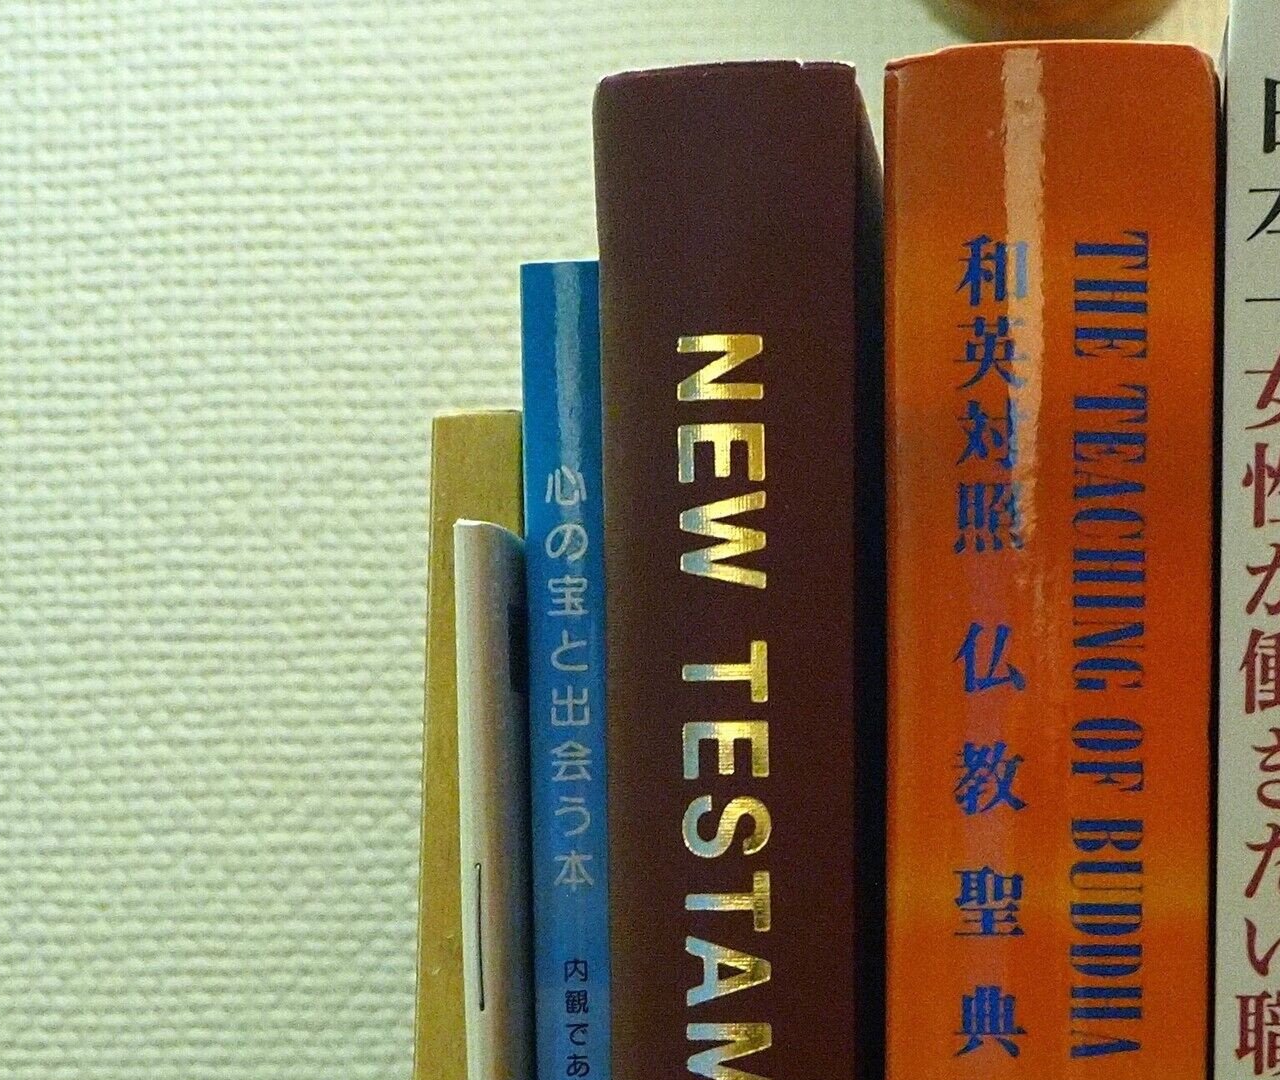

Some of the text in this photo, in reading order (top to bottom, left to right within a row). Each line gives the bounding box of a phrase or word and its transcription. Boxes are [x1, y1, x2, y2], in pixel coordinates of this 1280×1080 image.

[676, 332, 767, 590] NEW
[953, 233, 1030, 555] 和英対照
[544, 465, 594, 890] 心の宝と出会う本
[1069, 230, 1150, 1058] THE TEACHING OF BUDDHA
